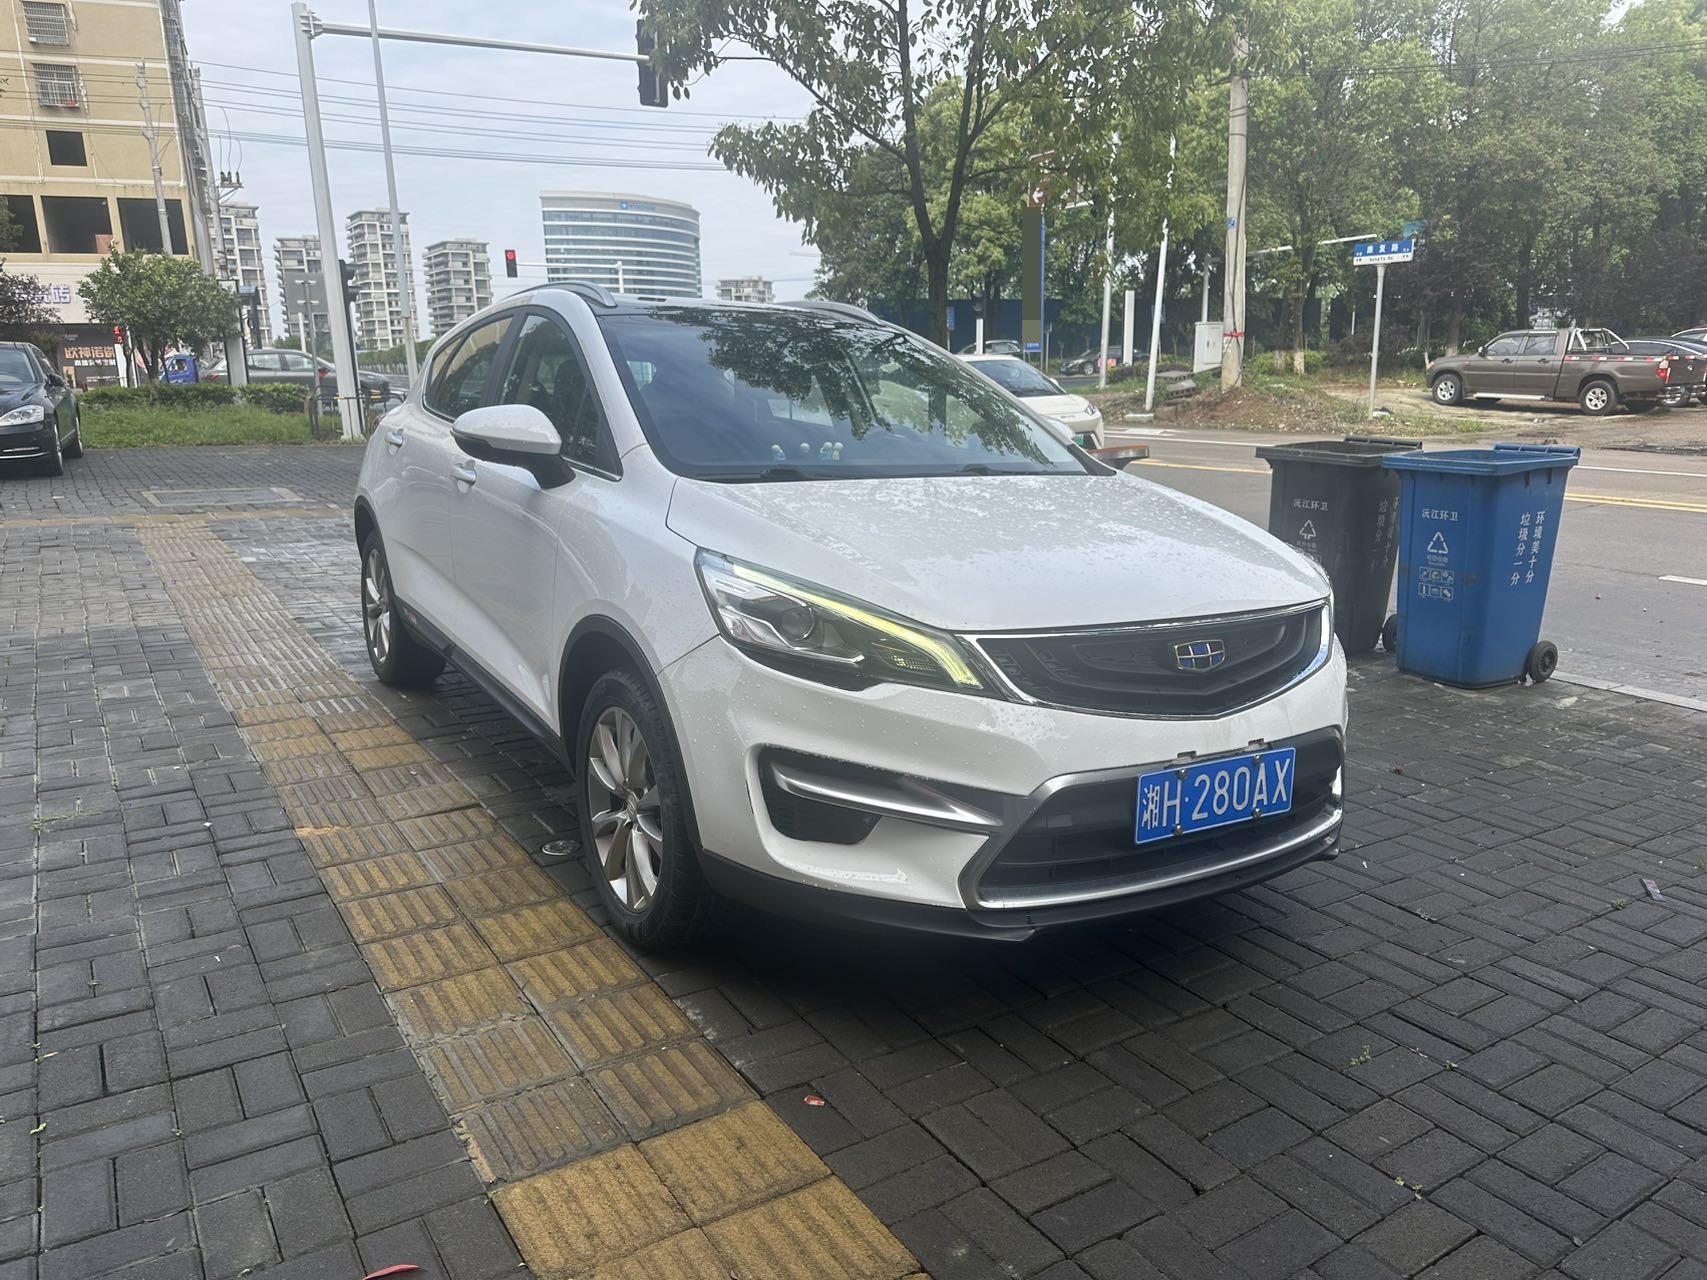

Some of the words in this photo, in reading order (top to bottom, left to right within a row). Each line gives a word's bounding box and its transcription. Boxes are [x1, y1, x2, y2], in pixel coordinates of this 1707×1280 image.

[1293, 497, 1328, 511] 沅江环卫
[1421, 508, 1459, 522] 沅江环卫
[1510, 511, 1531, 586] 垃圾分一分
[1525, 510, 1545, 584] 环境美十分
